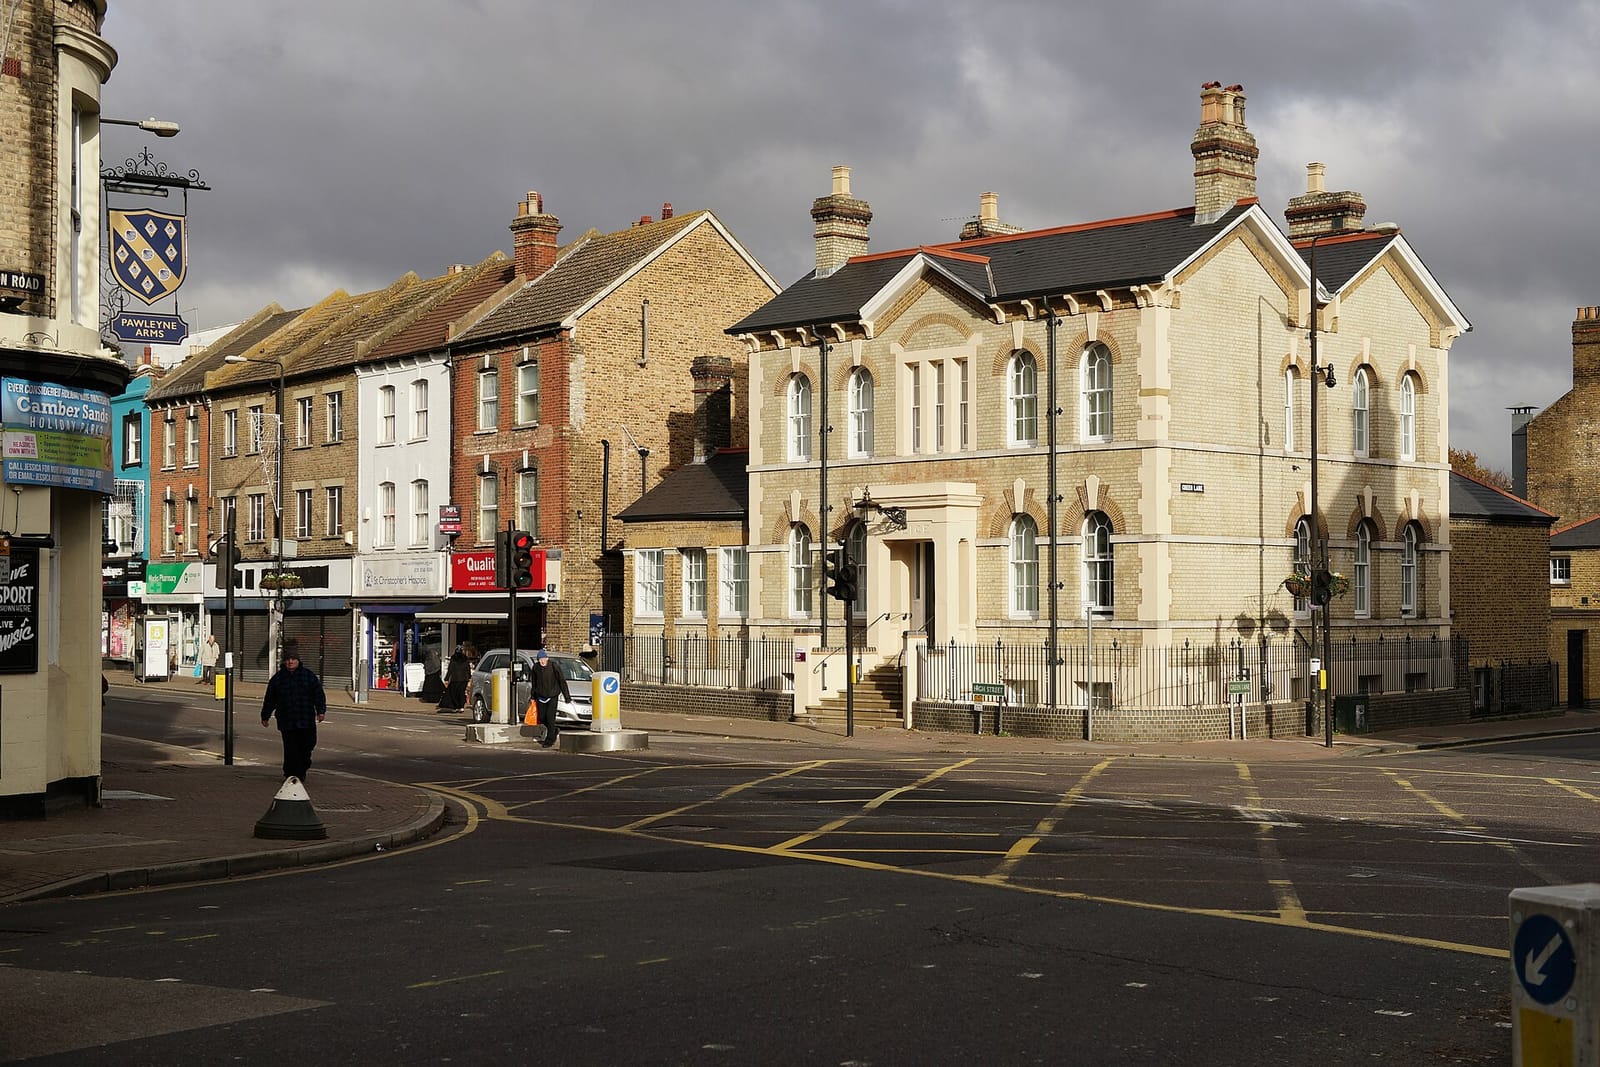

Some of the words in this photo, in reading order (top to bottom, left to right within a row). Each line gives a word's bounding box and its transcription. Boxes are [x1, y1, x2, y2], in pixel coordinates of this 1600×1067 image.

[11, 274, 40, 290] ROAD
[121, 318, 178, 330] PAWLEYNE
[135, 328, 165, 338] ARMS
[8, 382, 24, 393] EVER
[16, 395, 80, 418] Camber
[82, 403, 109, 424] Sands
[30, 416, 76, 432] HOLIDAY
[8, 462, 23, 470] CALL
[10, 563, 30, 581] IVE
[466, 557, 496, 572] Qualit
